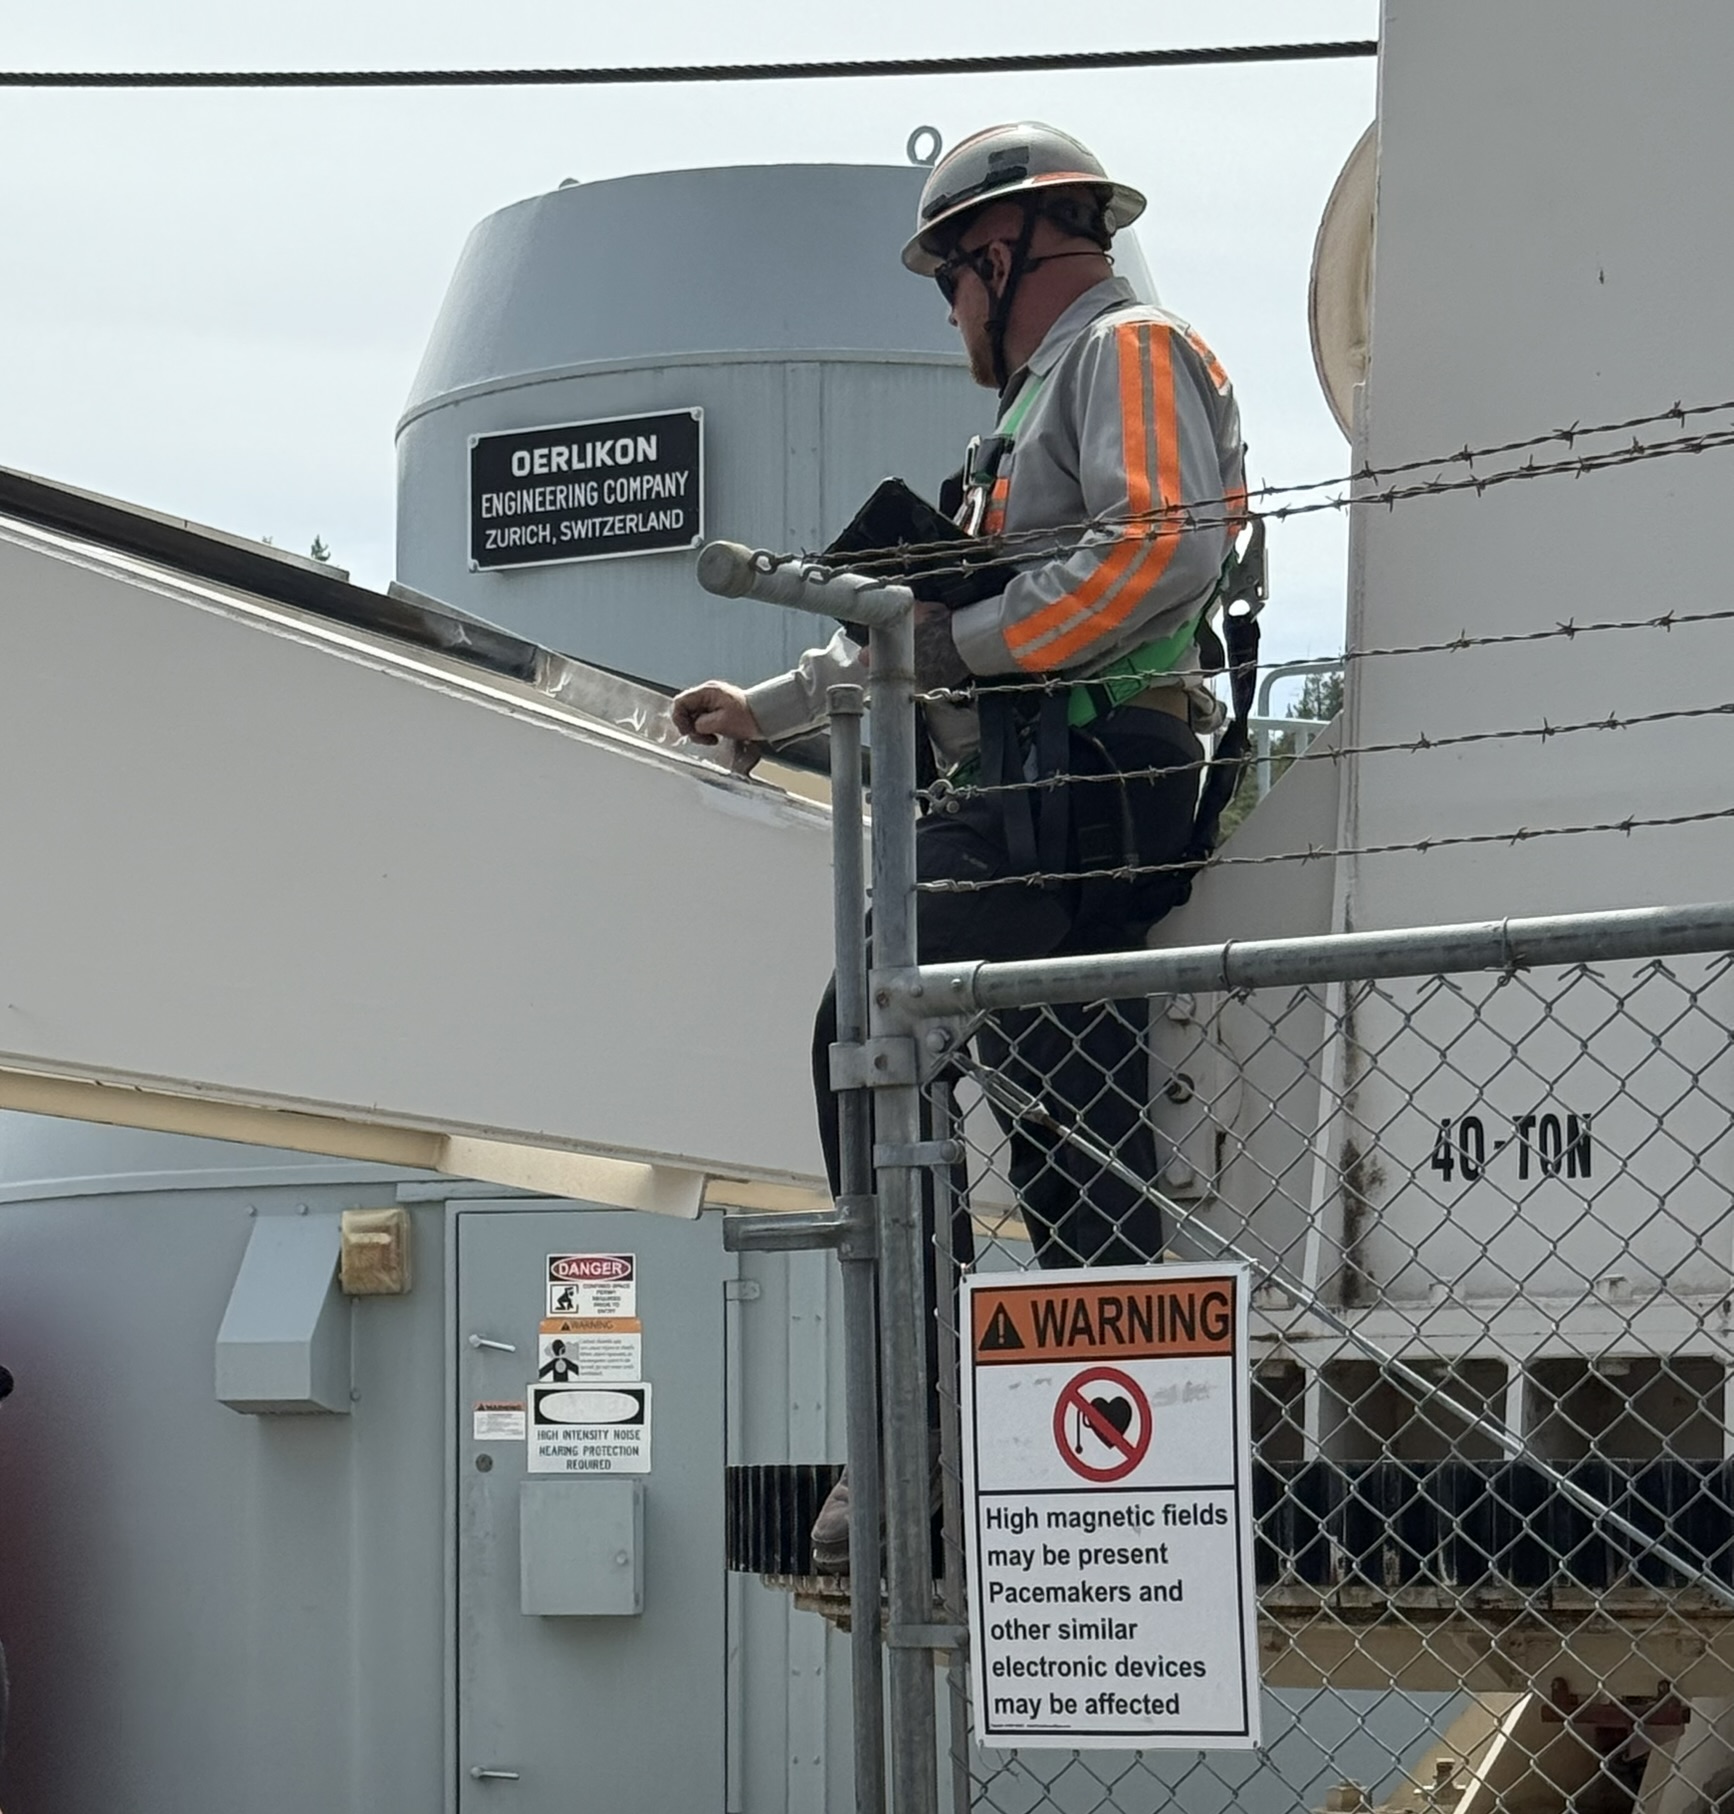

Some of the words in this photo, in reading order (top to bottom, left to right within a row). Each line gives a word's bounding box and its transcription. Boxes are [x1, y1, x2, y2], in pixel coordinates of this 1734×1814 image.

[511, 434, 657, 477] OERLIKON
[481, 481, 598, 519] ENGINEERING
[603, 470, 689, 504] COMPANY
[485, 524, 557, 549] ZURICH,
[560, 508, 684, 541] SWITZERLAND
[1431, 1113, 1592, 1182] 40-TON
[558, 1262, 623, 1275] DANGER
[571, 1320, 614, 1330] WARNING
[1030, 1291, 1229, 1348] WARNING
[537, 1429, 559, 1441] HIGH
[562, 1429, 609, 1441] INTENSITY
[613, 1429, 641, 1441] NOISE
[539, 1445, 579, 1457] HEARING
[583, 1445, 640, 1457] PROTECTION
[566, 1459, 612, 1470] REQUIRED
[985, 1506, 1039, 1535] High
[1047, 1504, 1155, 1533] magnetic
[1162, 1503, 1228, 1526] fields
[988, 1549, 1036, 1571] may
[1043, 1543, 1070, 1565] be
[1079, 1542, 1169, 1570] present
[989, 1580, 1131, 1603] Pacemakers
[1139, 1579, 1183, 1602] and
[991, 1618, 1051, 1641] other
[1058, 1617, 1138, 1640] similar
[992, 1655, 1108, 1678] electronic
[1115, 1655, 1207, 1678] devices
[994, 1696, 1042, 1720] may
[1050, 1692, 1077, 1715] be
[1085, 1692, 1180, 1715] affected
